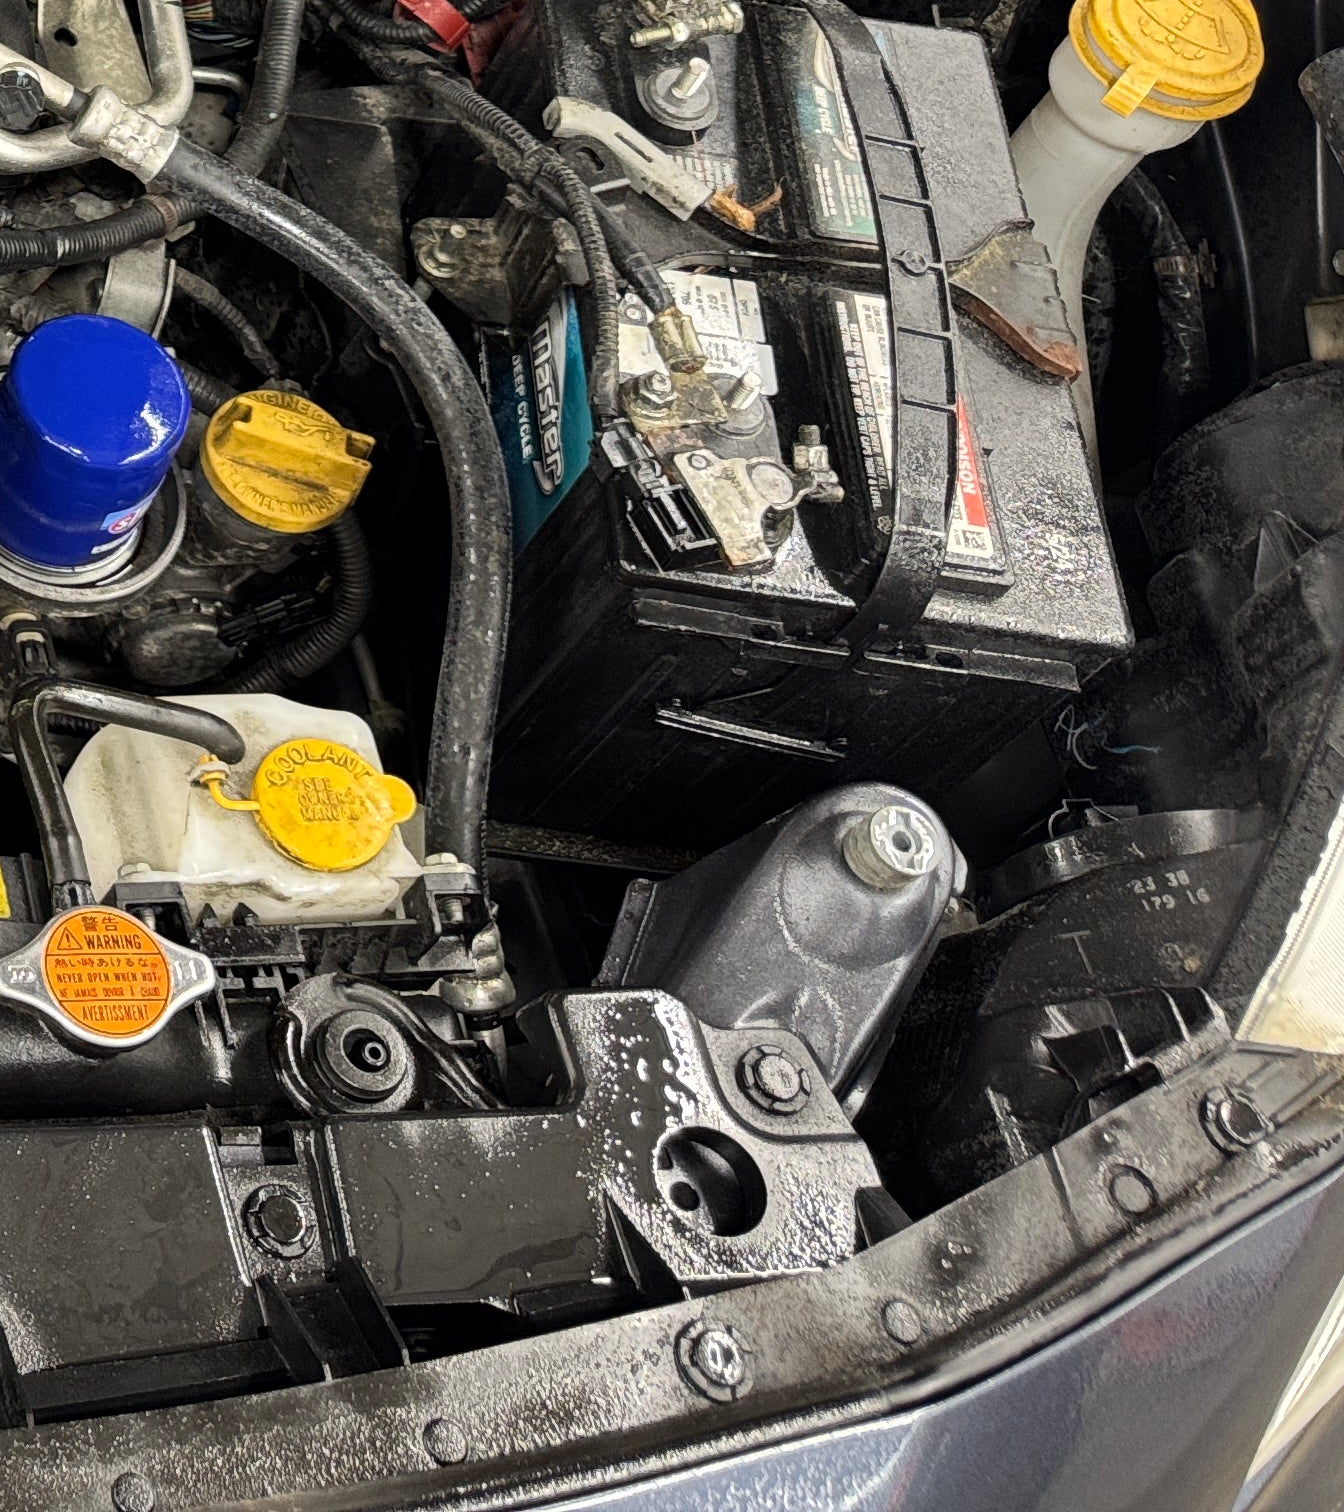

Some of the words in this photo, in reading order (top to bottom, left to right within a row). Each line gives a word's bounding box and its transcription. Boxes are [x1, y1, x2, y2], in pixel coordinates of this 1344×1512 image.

[511, 354, 527, 397] DEEP
[517, 400, 534, 459] CYCLE
[265, 743, 374, 787] COOLANT
[81, 916, 118, 932] 警告
[83, 934, 142, 950] WARNING
[56, 973, 83, 983] NEVER
[87, 973, 109, 982] OPEN
[114, 973, 137, 982] WHEN
